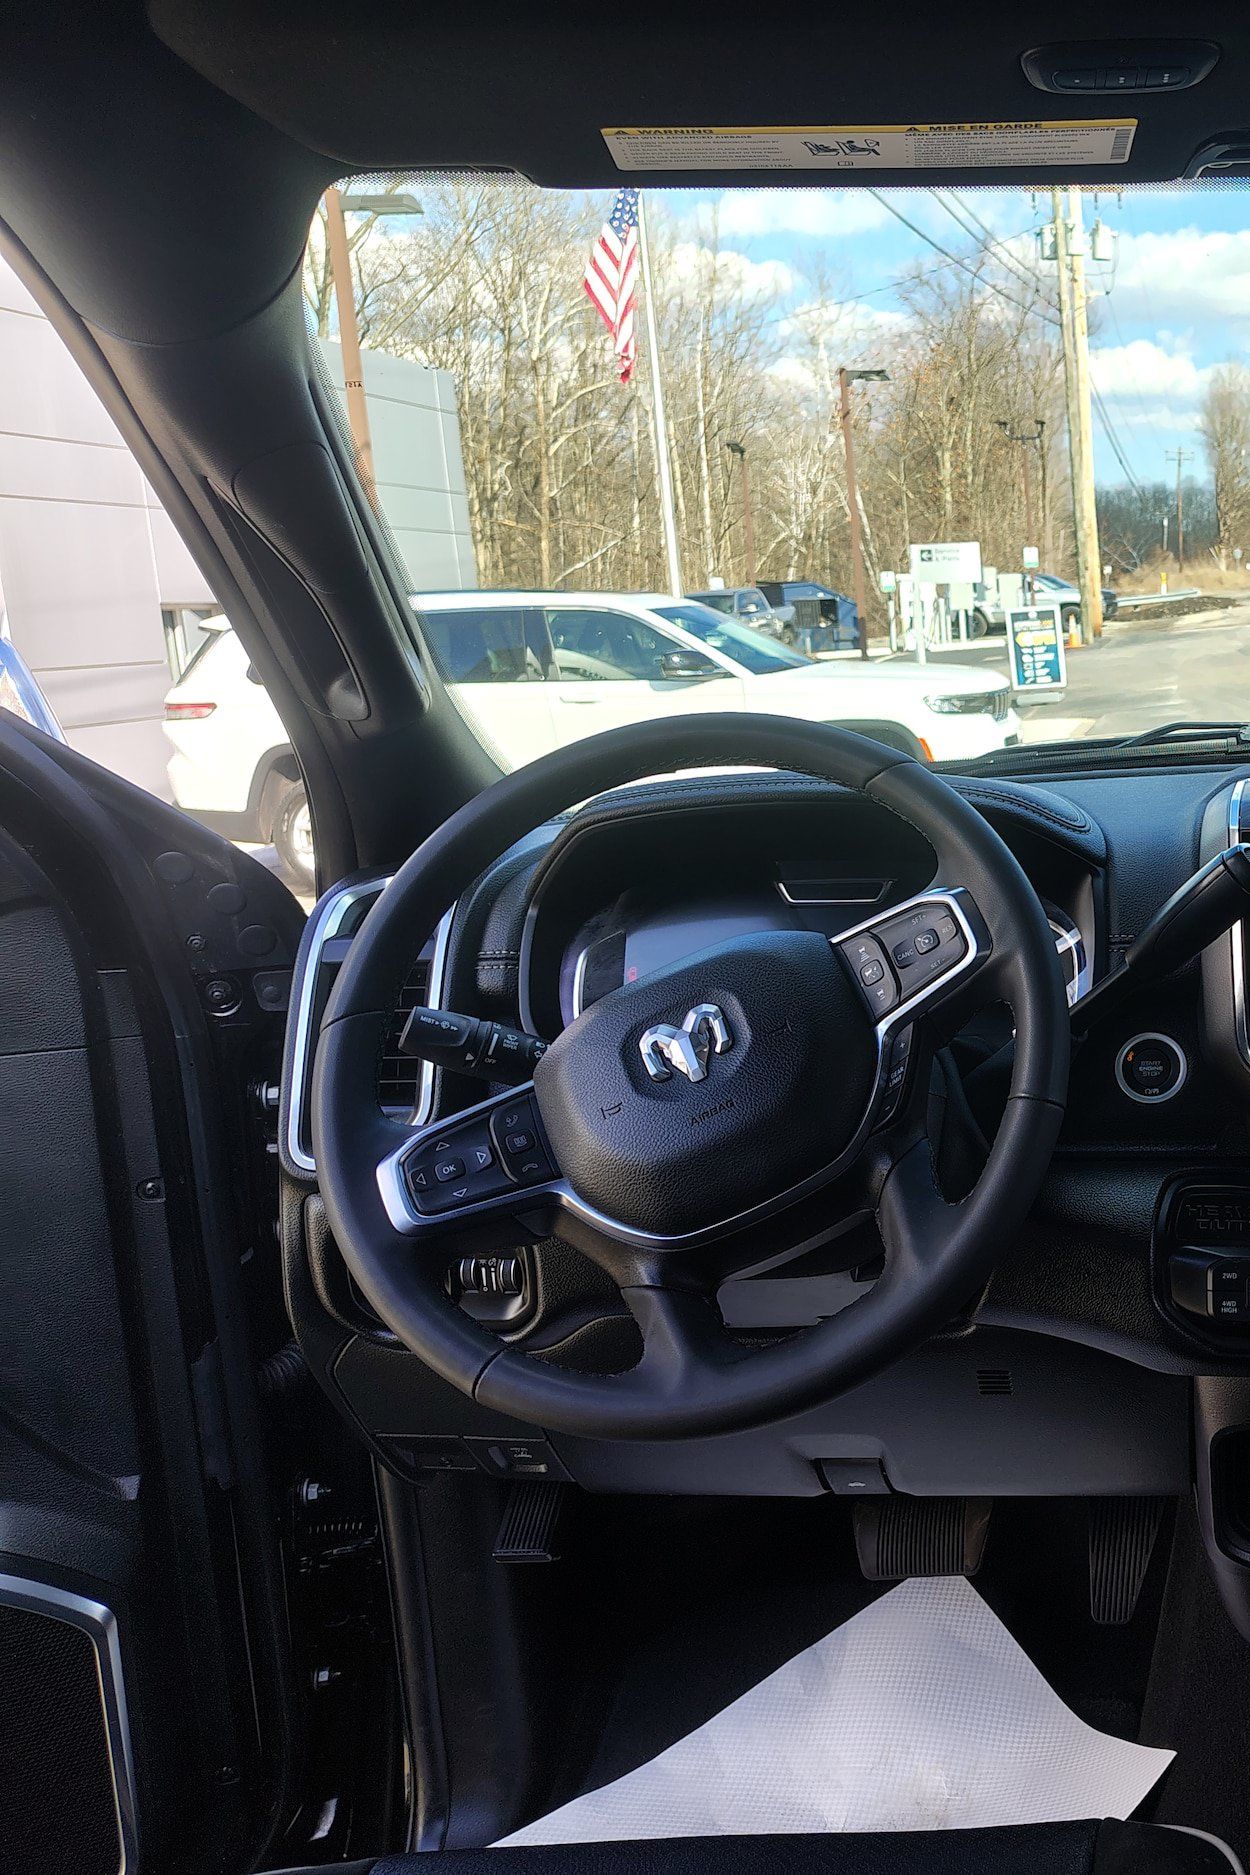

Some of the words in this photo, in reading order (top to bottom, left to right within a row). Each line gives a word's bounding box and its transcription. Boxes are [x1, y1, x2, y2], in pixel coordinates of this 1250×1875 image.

[897, 948, 914, 961] CANC
[690, 1099, 735, 1127] AIRBAG
[442, 1164, 457, 1176] OK
[1222, 1272, 1238, 1280] 2WD
[1221, 1306, 1238, 1314] HIGH
